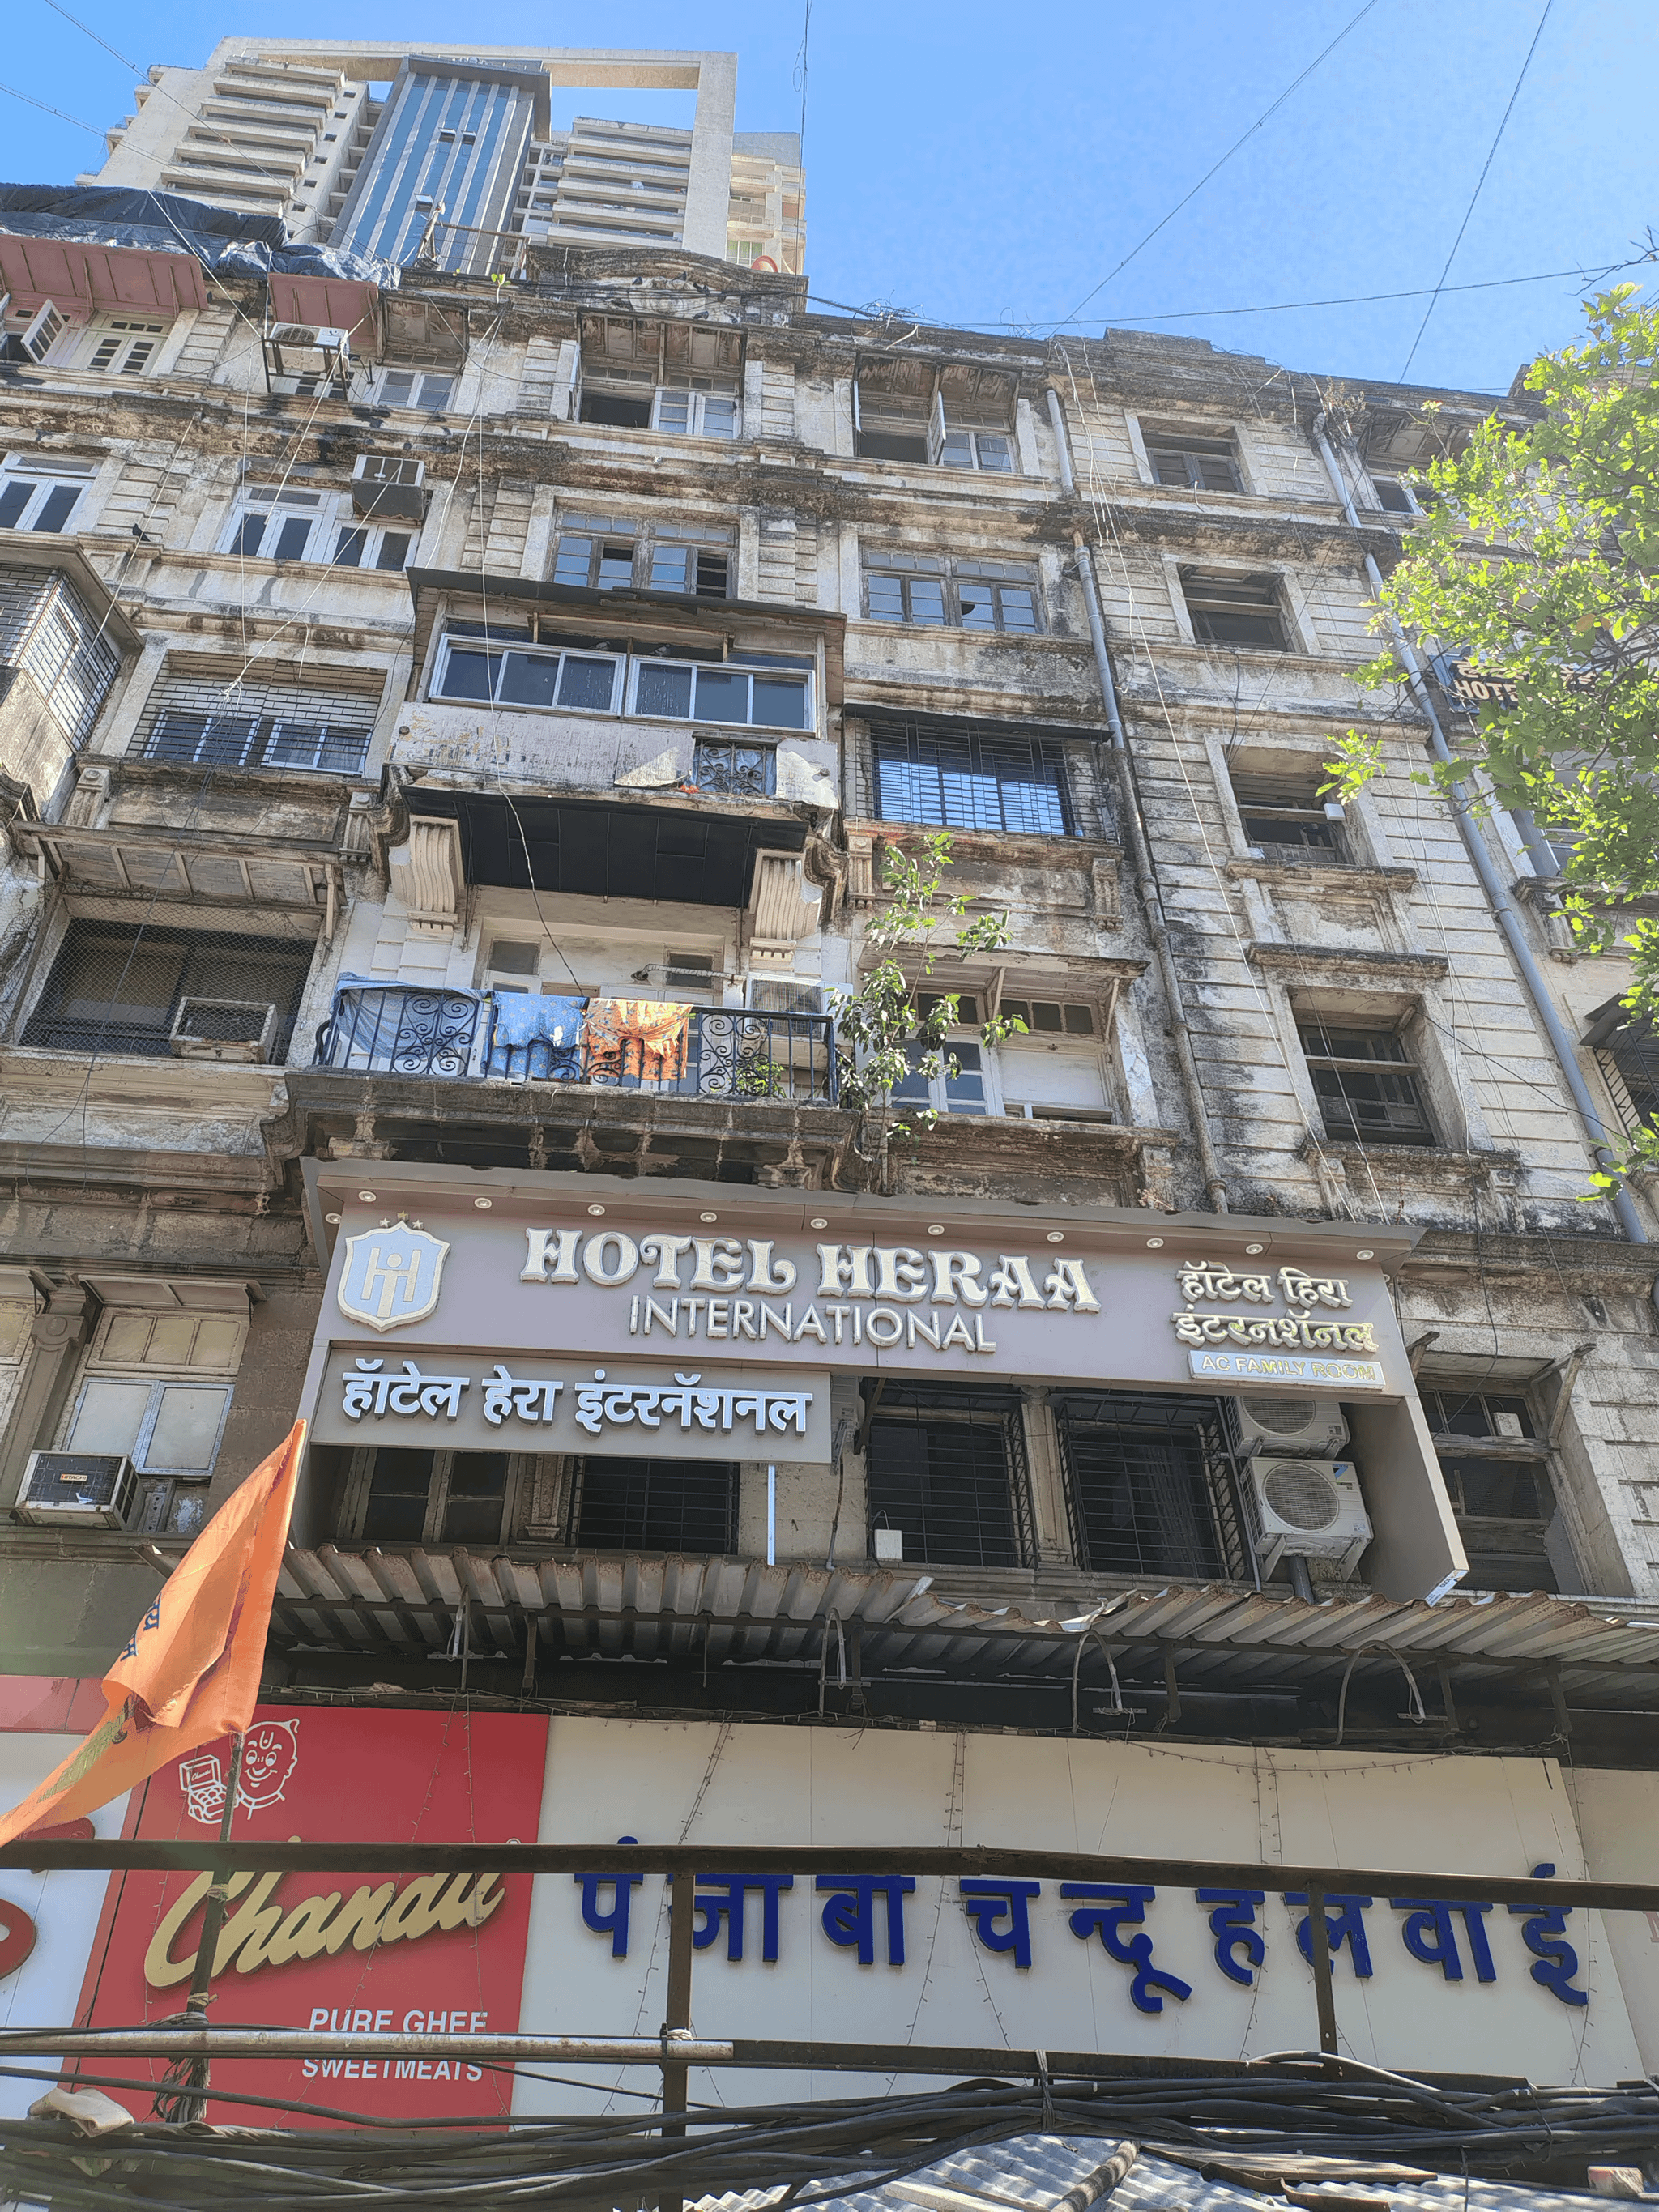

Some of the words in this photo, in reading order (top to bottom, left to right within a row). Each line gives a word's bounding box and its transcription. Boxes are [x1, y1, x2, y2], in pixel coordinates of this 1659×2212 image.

[1454, 680, 1533, 702] HOTE
[520, 1227, 797, 1294] HOTEL
[816, 1243, 1102, 1313] HERAA
[1176, 1260, 1275, 1303] हॉटेल
[1277, 1266, 1354, 1309] हिरा
[629, 1294, 997, 1353] INTERNATIONAL
[1201, 1355, 1230, 1371] AC
[1235, 1357, 1305, 1376] FAMILY
[1311, 1362, 1375, 1381] ROOM
[342, 1358, 471, 1423] हॉटेल
[481, 1364, 564, 1428] हेरा
[575, 1368, 813, 1437] इंटरनॅशनल
[144, 1835, 505, 1989] Chandu
[1195, 1863, 1588, 2006] हलवाई
[309, 2008, 394, 2032] PURE
[403, 2010, 488, 2033] GHEE
[302, 2059, 483, 2081] SWEETMEATS
